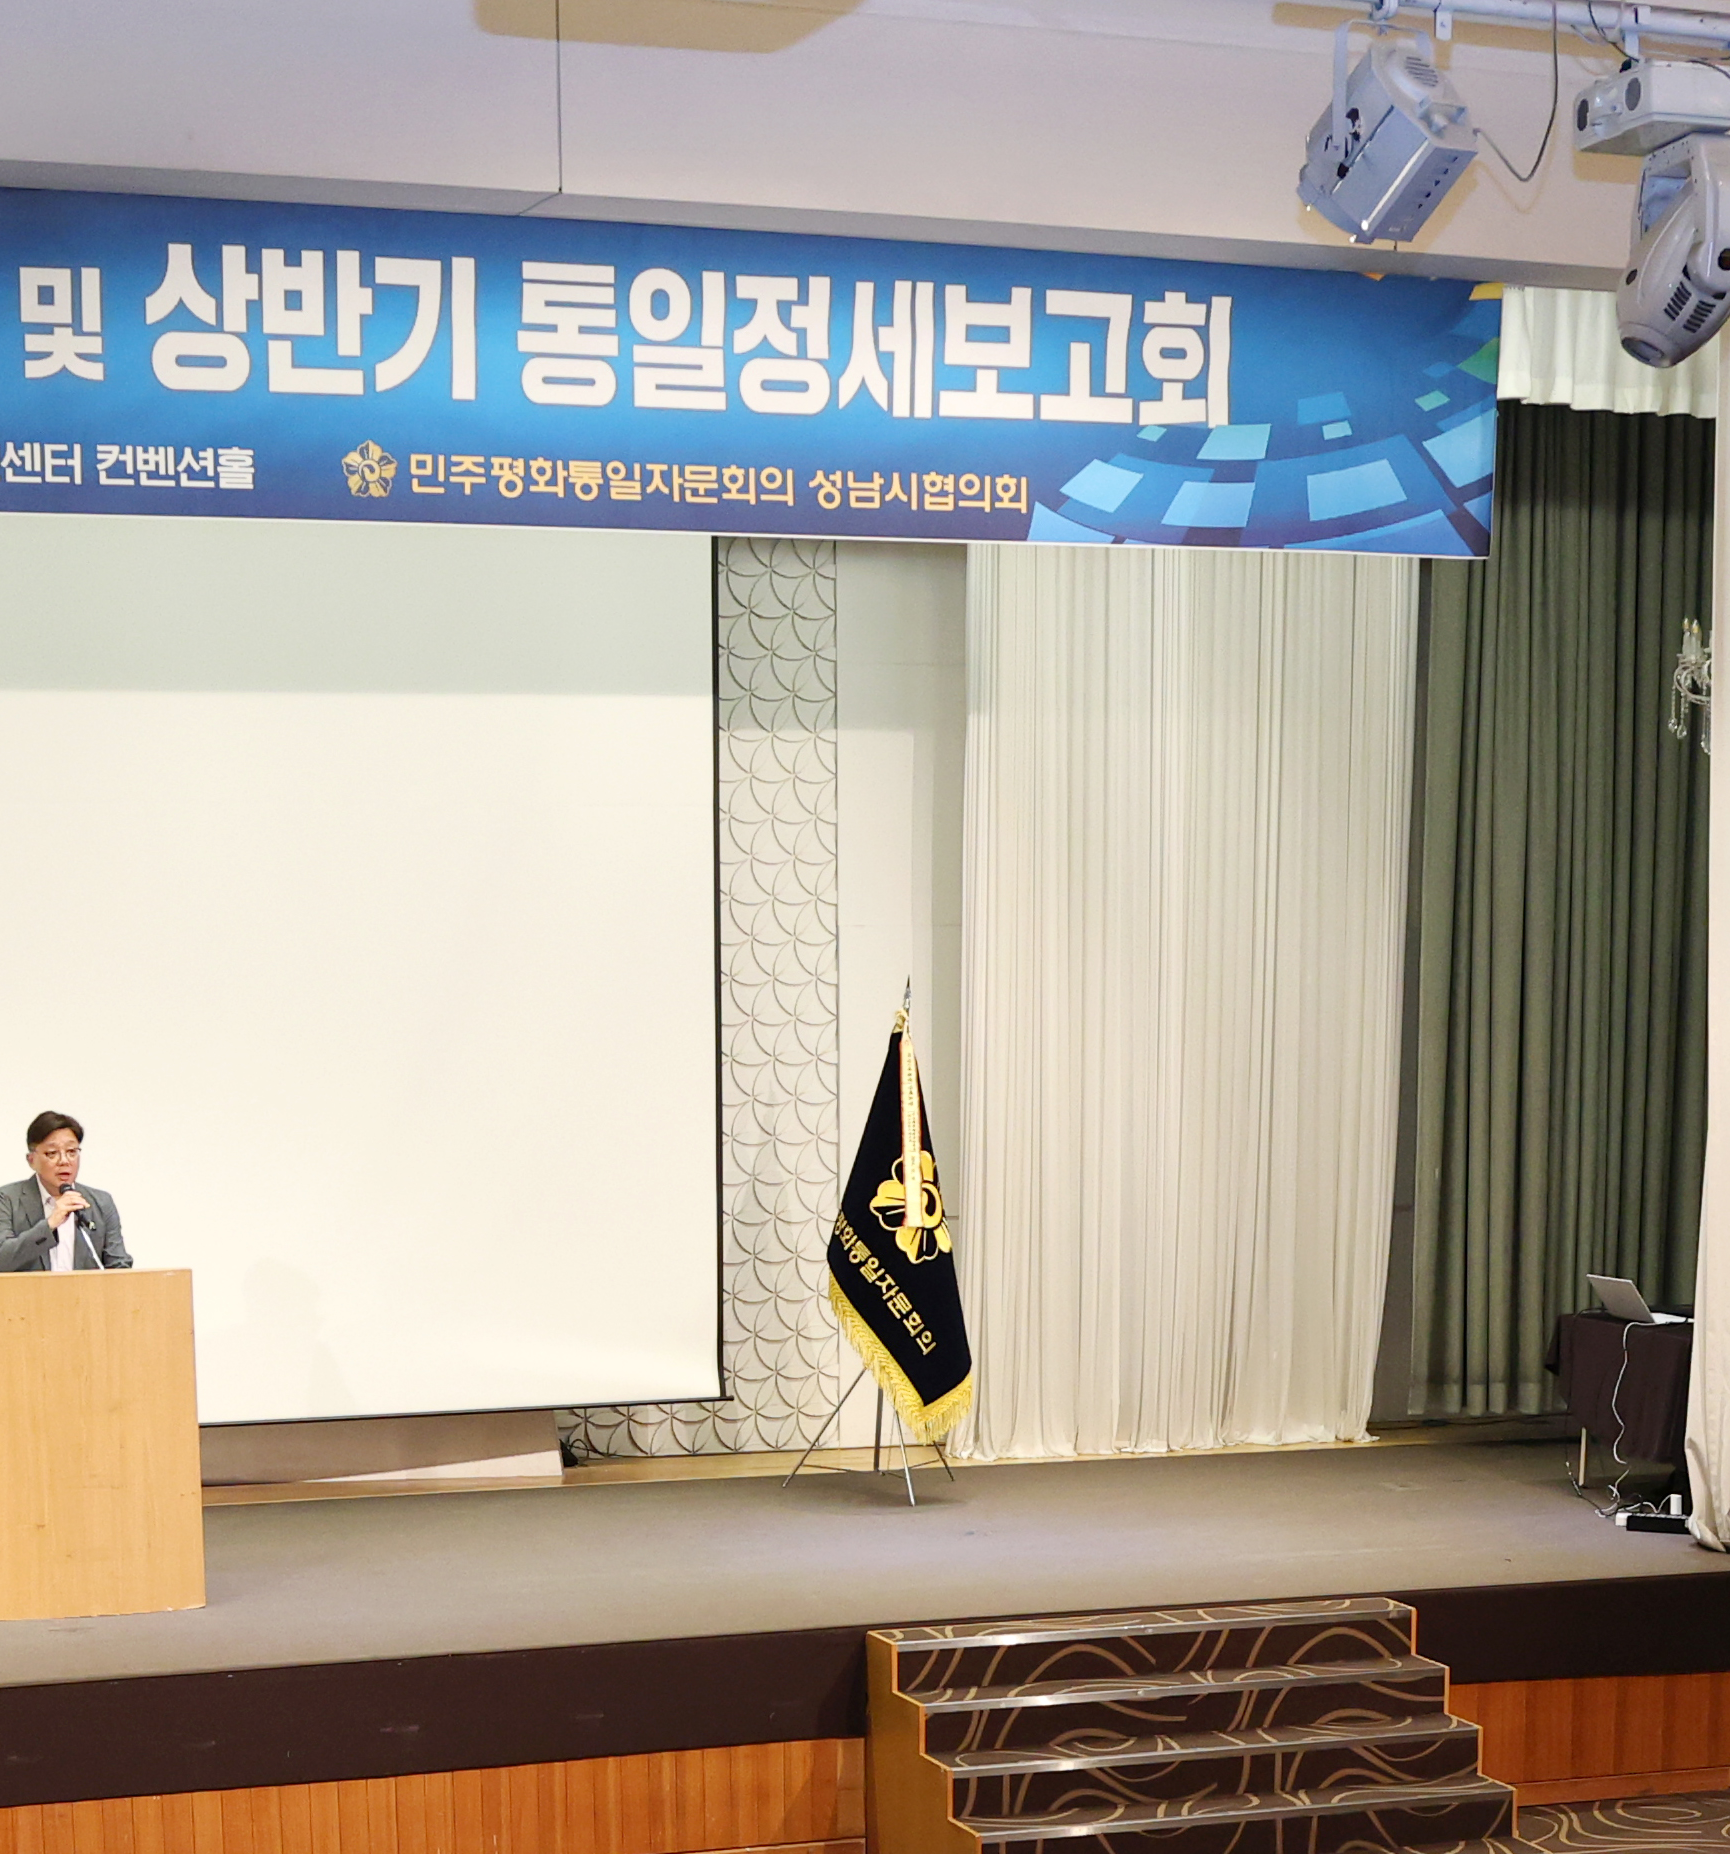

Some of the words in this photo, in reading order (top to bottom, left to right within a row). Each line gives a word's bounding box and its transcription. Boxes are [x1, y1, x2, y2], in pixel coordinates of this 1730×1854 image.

[20, 267, 104, 381] 및
[146, 244, 476, 400] 상반기
[517, 261, 1231, 428] 통일정세보고회
[97, 445, 254, 489] 컨벤션홀
[411, 454, 793, 506] 민주평화통일자문회의
[809, 470, 1027, 513] 성남시협의회
